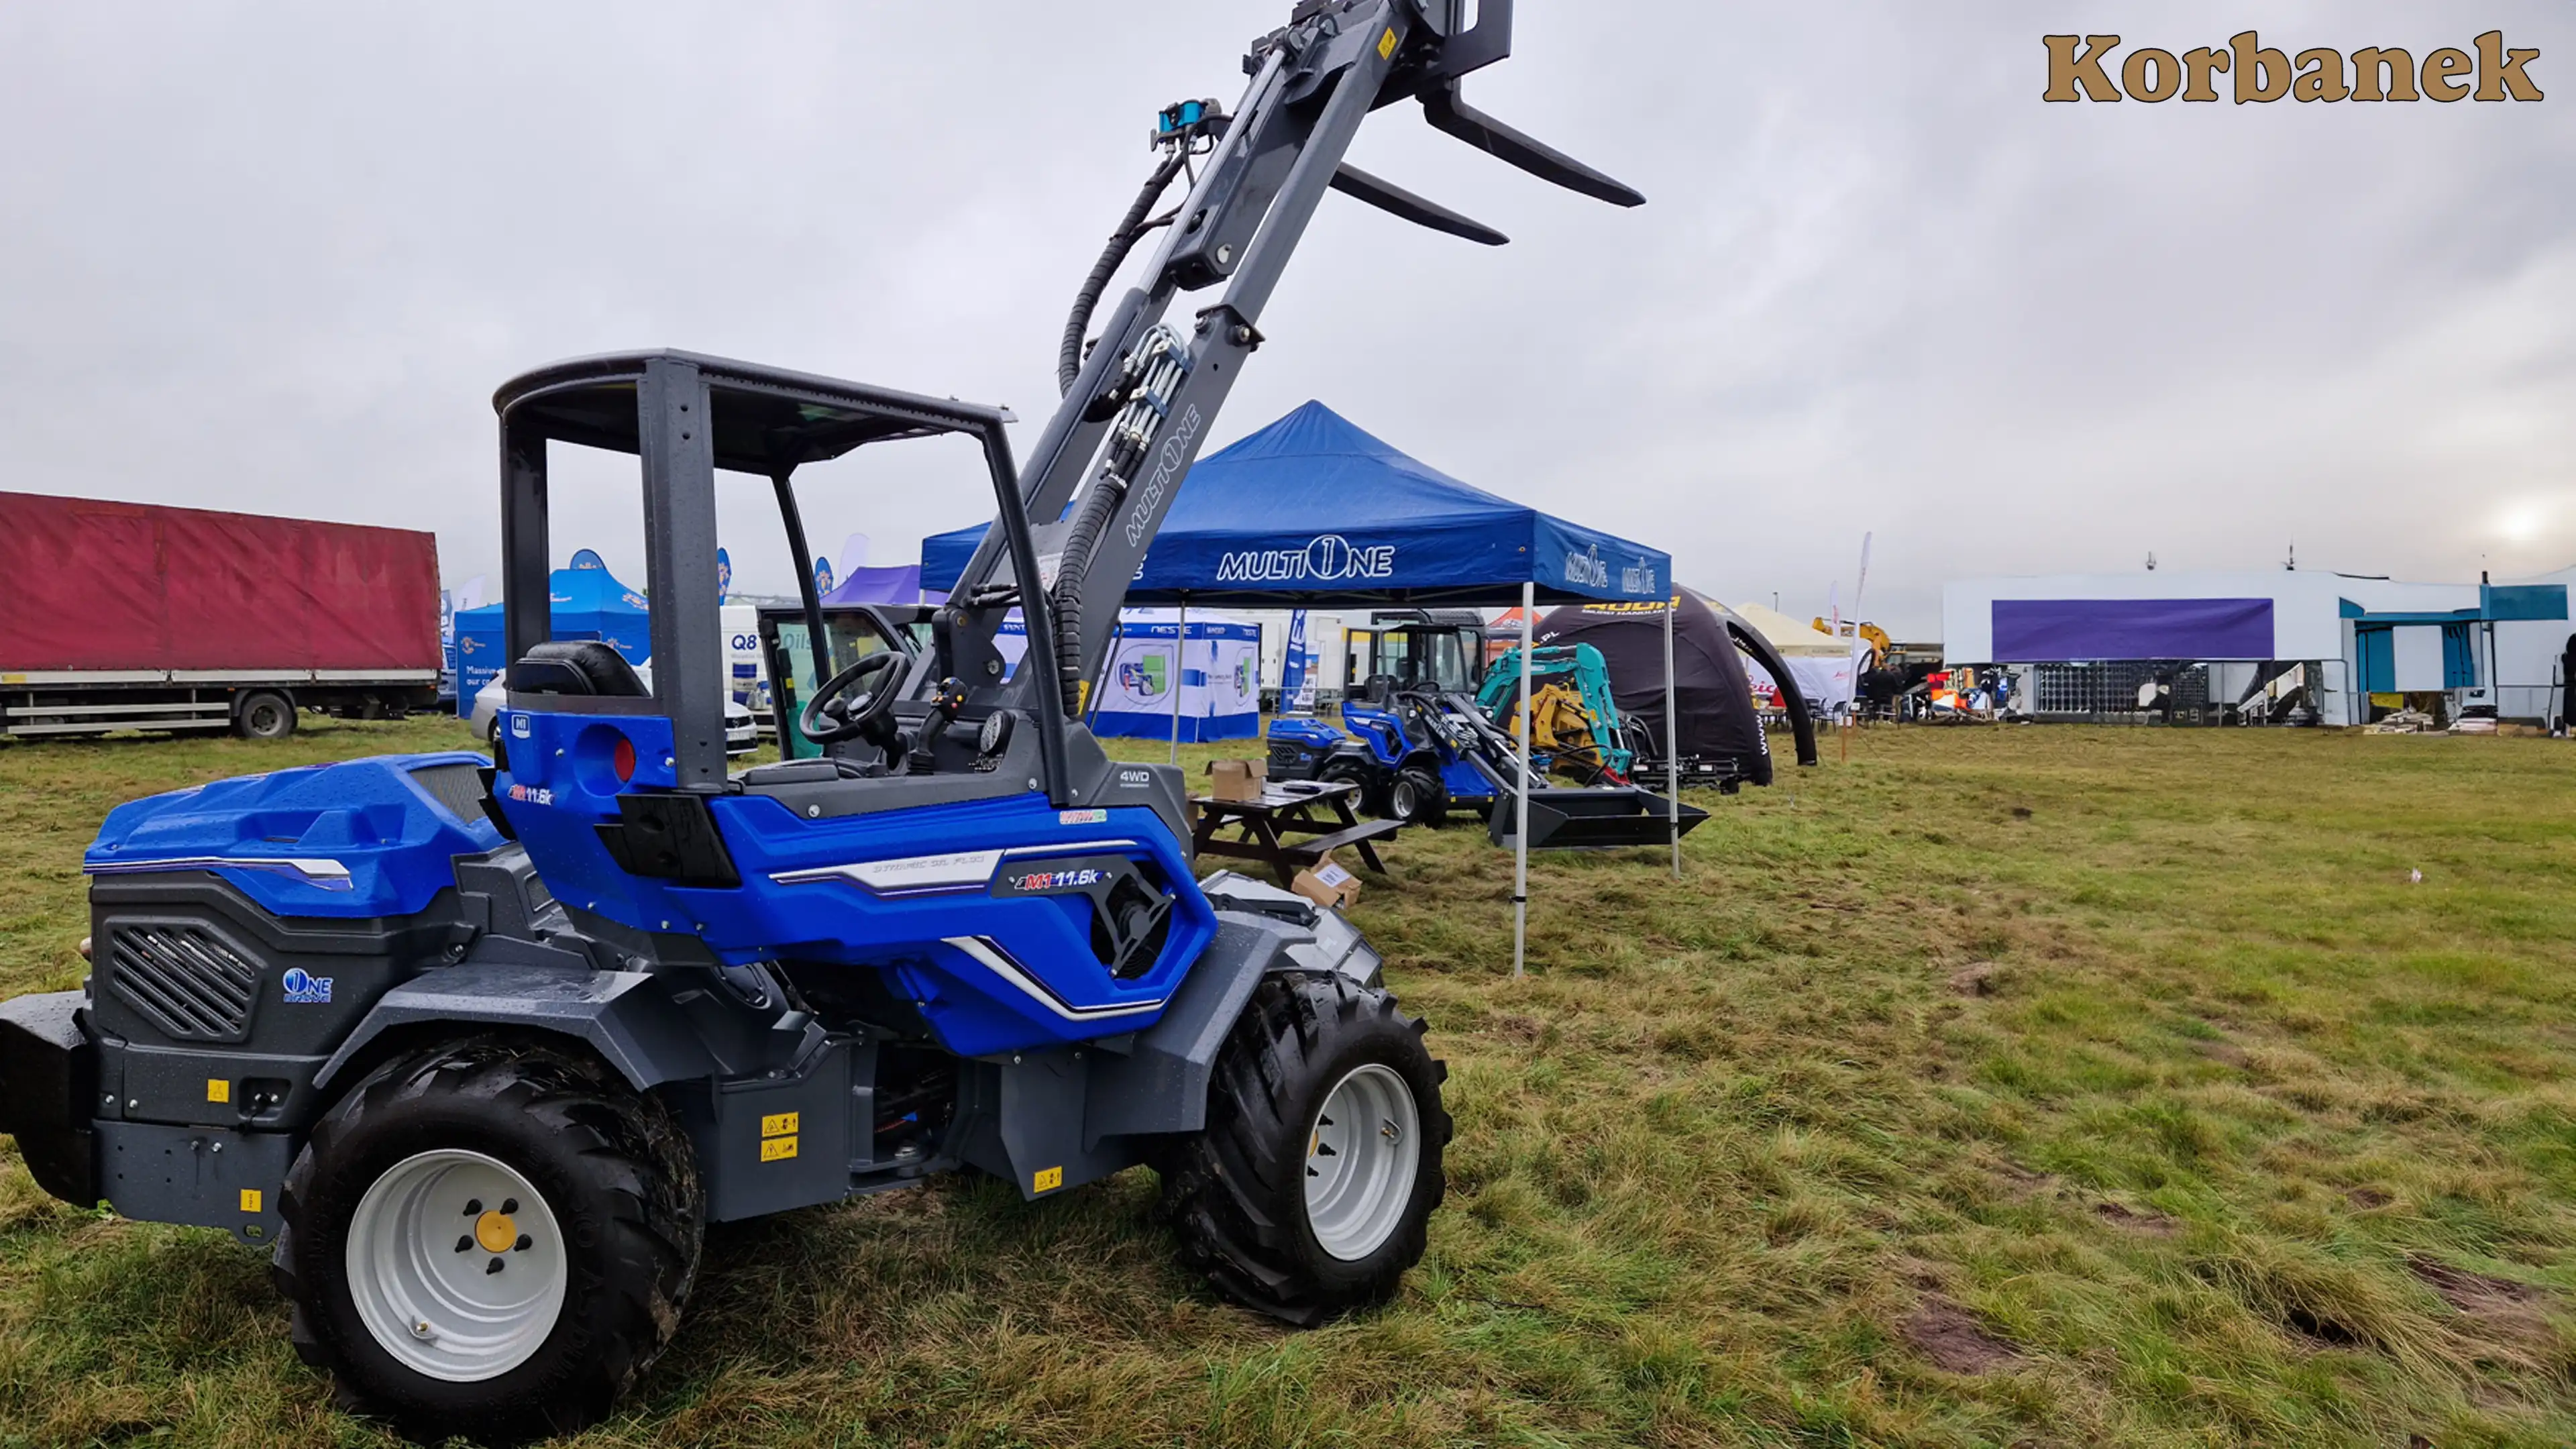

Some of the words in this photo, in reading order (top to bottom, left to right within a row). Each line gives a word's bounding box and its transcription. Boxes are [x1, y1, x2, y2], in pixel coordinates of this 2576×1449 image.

[731, 634, 757, 651] Q8
[1120, 771, 1150, 782] 4WD
[1025, 873, 1053, 891] M1
[1055, 869, 1099, 887] 11.6k
